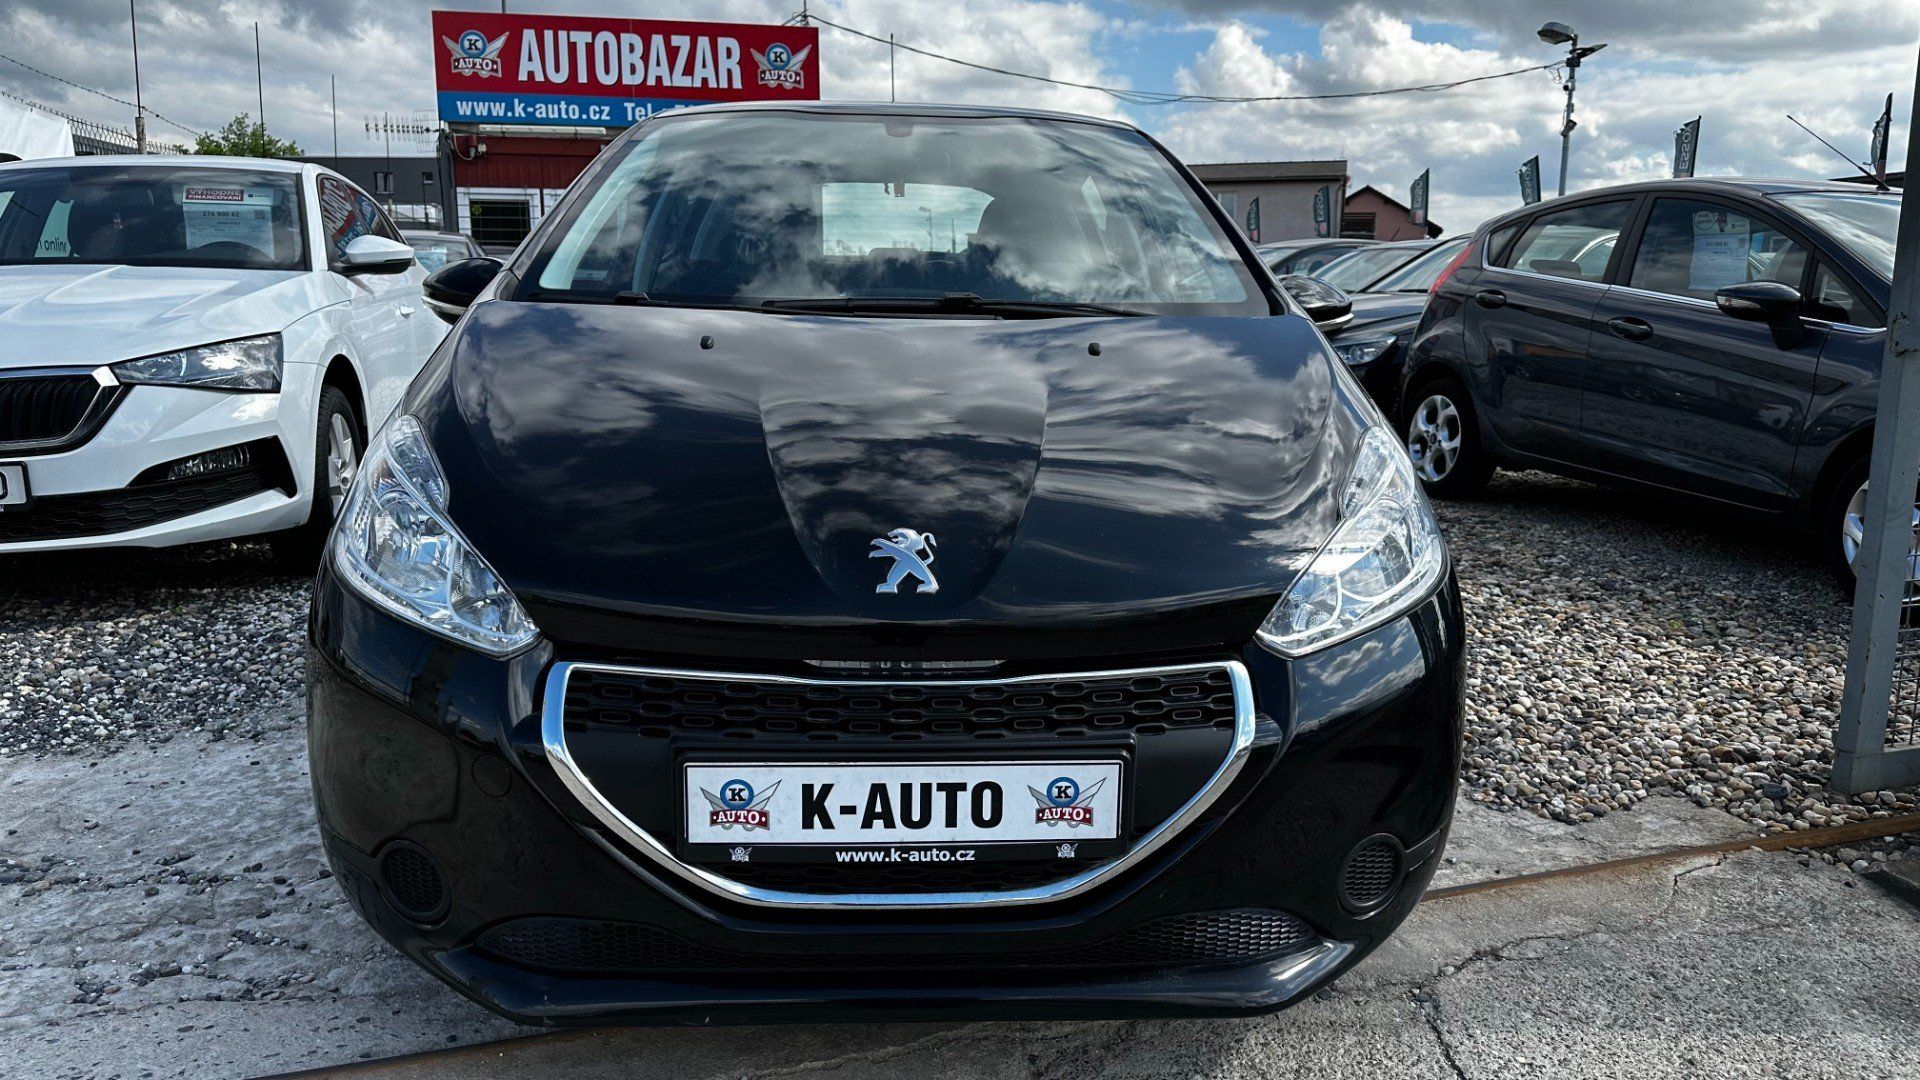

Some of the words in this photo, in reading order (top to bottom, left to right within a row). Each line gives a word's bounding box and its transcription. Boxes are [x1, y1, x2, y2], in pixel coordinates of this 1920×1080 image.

[466, 38, 481, 51] K
[517, 28, 743, 89] AUTOBAZAR
[772, 51, 786, 63] K
[458, 58, 493, 71] AUTO
[764, 70, 796, 83] AUTO
[456, 98, 611, 121] www.k-auto.cz
[728, 787, 746, 802] K
[1055, 785, 1071, 799] K
[801, 780, 1004, 830] K-AUTO
[717, 809, 760, 824] AUTO
[1043, 807, 1085, 821] AUTO
[835, 847, 975, 862] www.k-auto.cz
